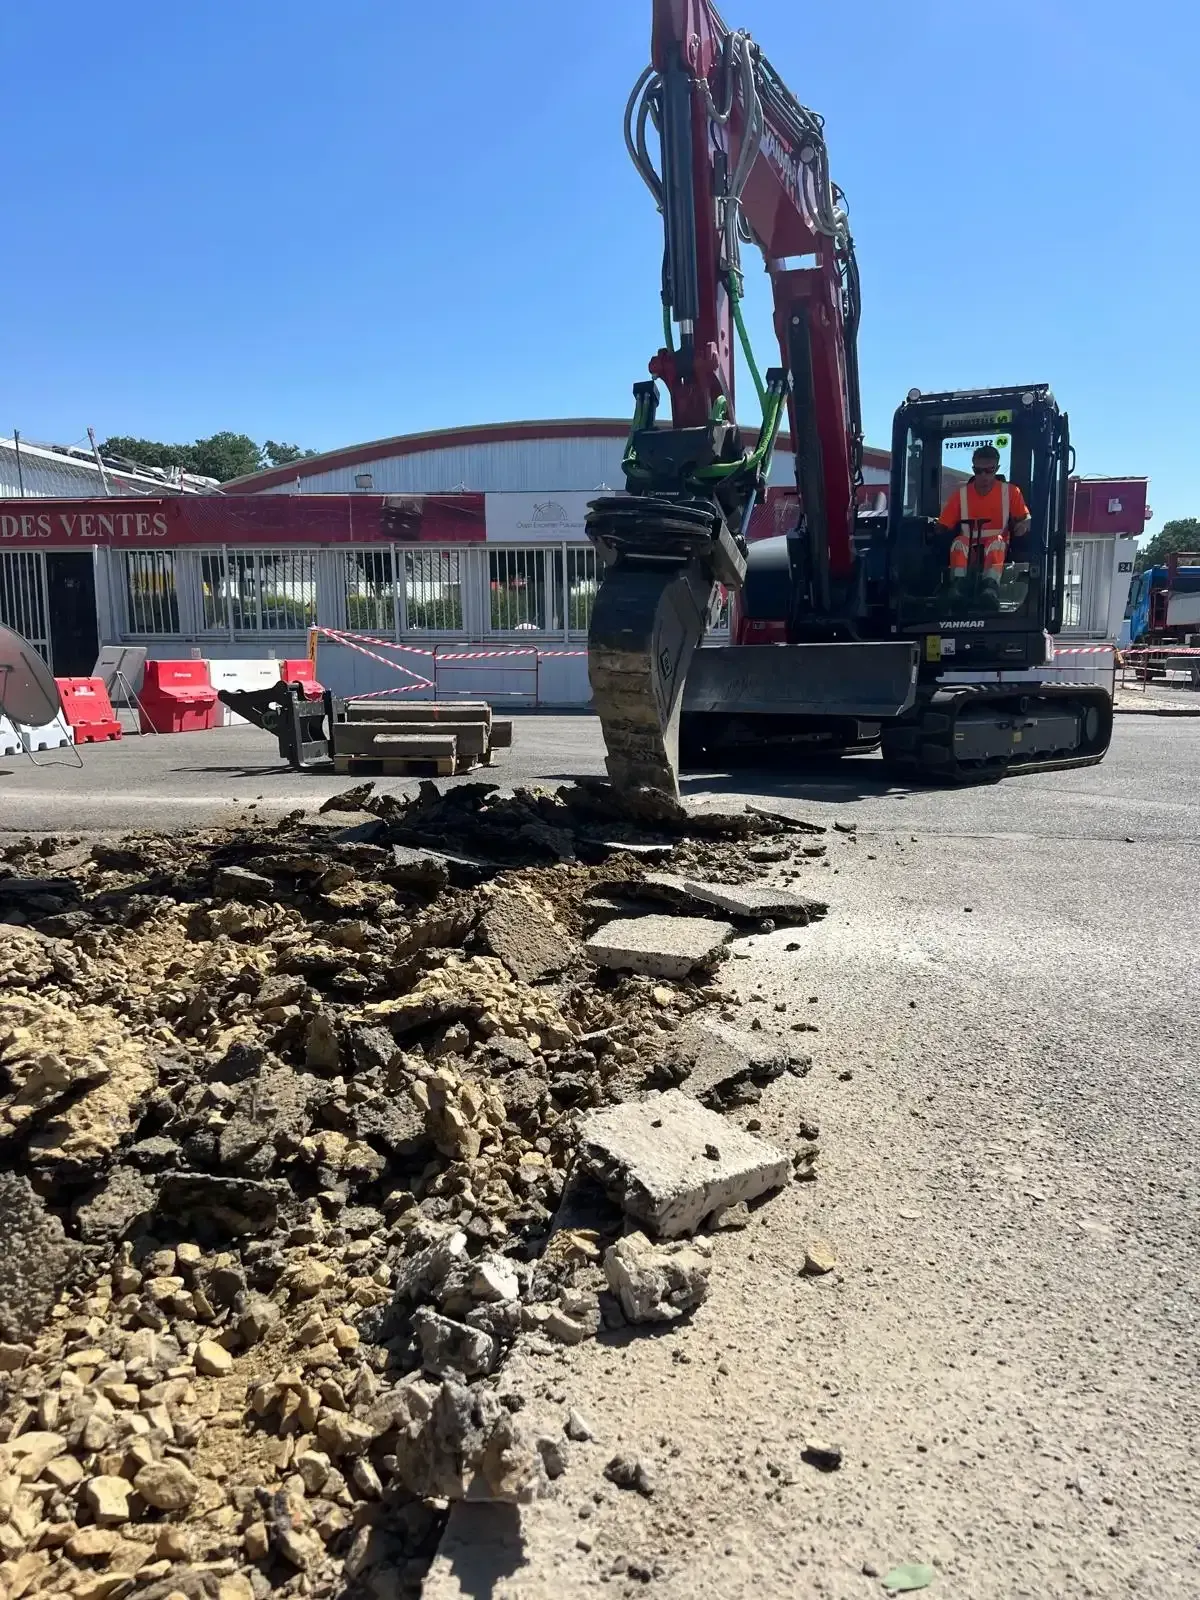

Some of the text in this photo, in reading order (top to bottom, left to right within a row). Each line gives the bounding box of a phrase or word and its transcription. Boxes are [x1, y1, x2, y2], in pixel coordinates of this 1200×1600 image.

[0, 512, 168, 538] DES VENTES
[939, 620, 985, 629] YANMAR
